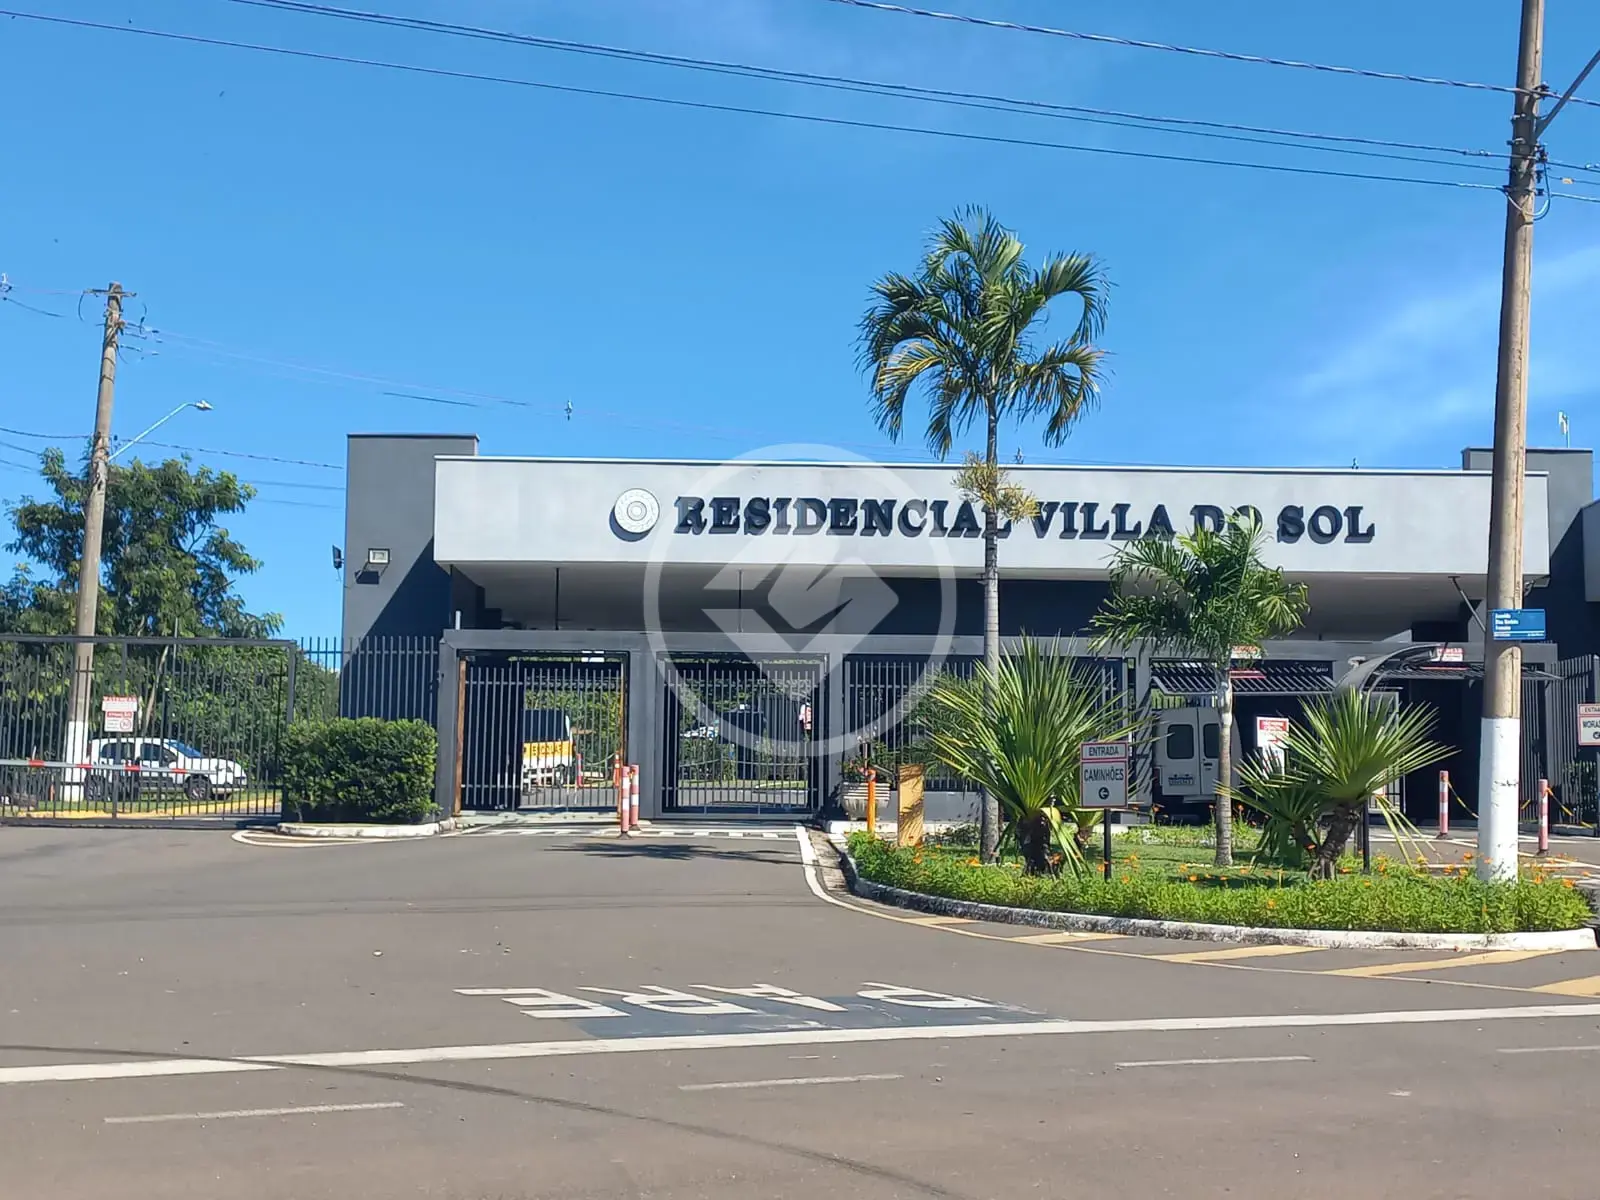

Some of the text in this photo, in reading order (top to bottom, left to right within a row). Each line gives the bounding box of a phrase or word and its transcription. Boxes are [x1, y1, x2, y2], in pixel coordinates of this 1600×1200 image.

[674, 496, 1375, 544] RESIDENCIAL VILLA DO SOL
[532, 743, 562, 756] ECOLAR
[1088, 746, 1119, 756] ENTRADA
[1084, 766, 1124, 781] CAMINHÕES
